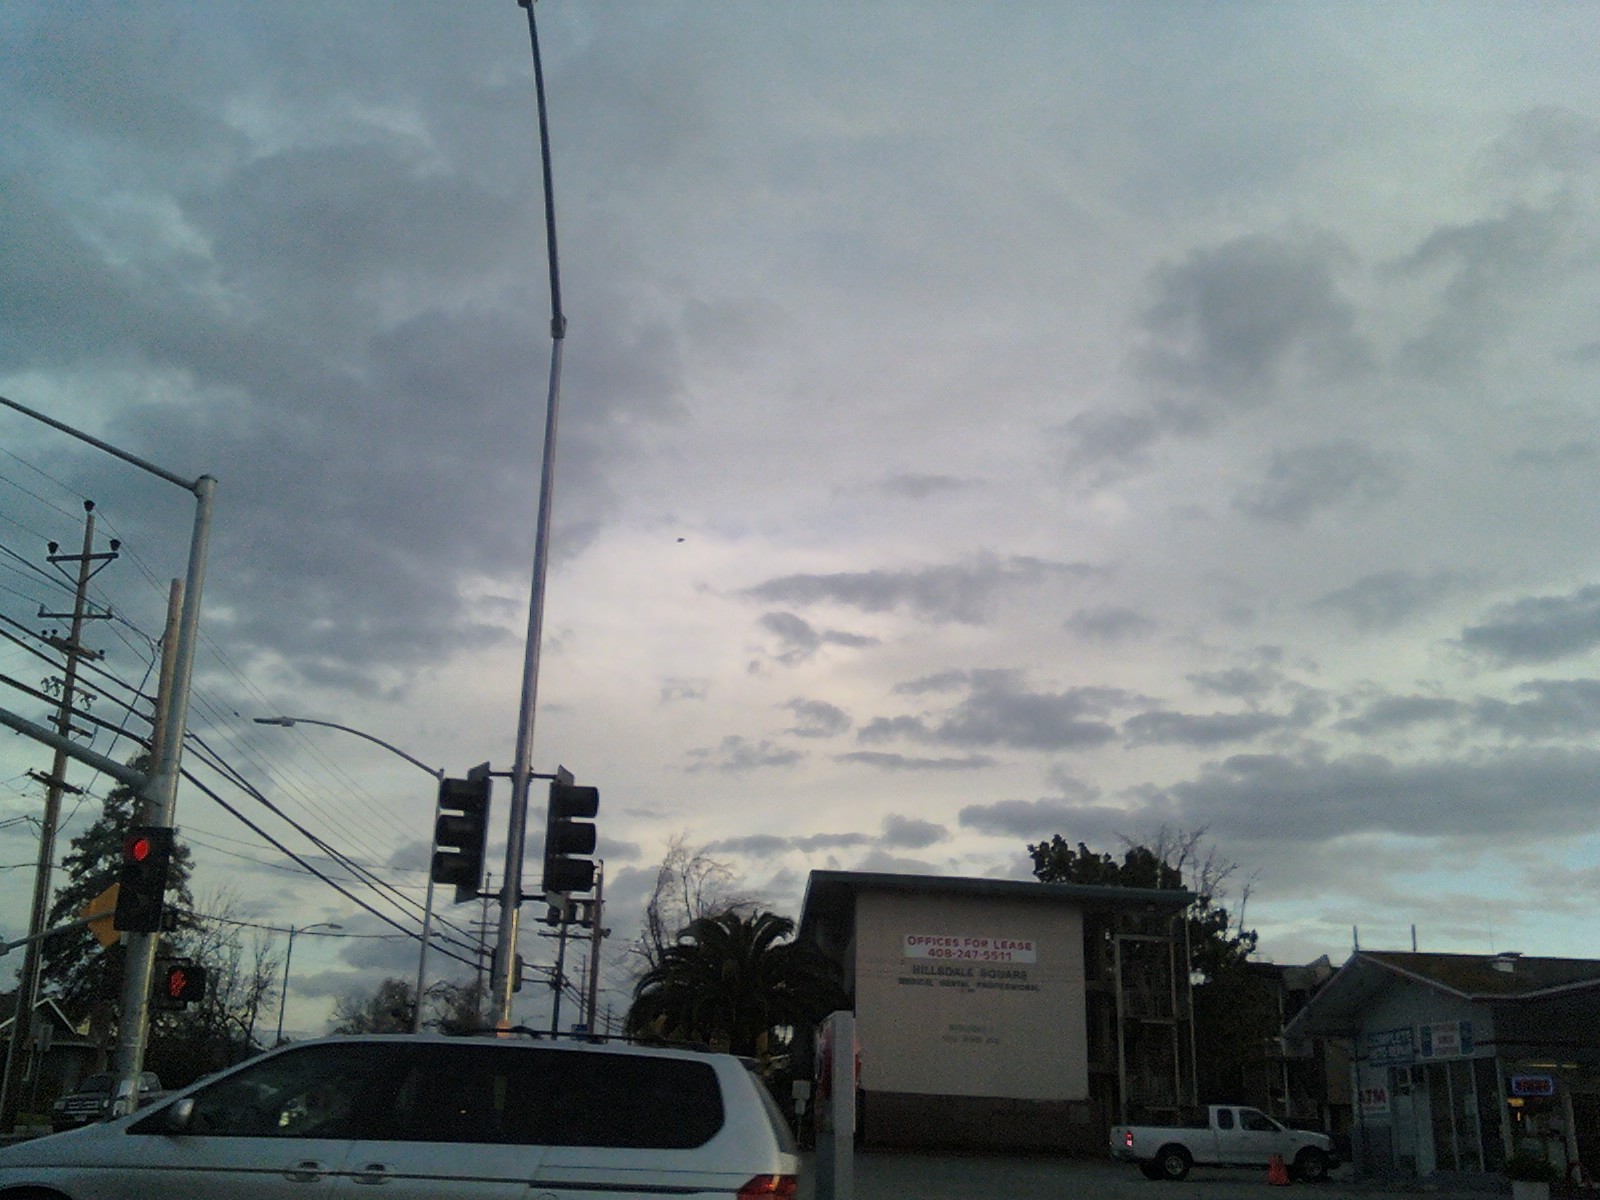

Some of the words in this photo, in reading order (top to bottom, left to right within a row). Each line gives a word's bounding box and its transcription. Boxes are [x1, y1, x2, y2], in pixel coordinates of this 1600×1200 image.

[907, 935, 960, 947] OFFICES
[964, 938, 988, 948] FOR
[993, 940, 1032, 951] LEASE
[928, 948, 1012, 961] 408-247-5511
[912, 965, 974, 977] HILLSDALE
